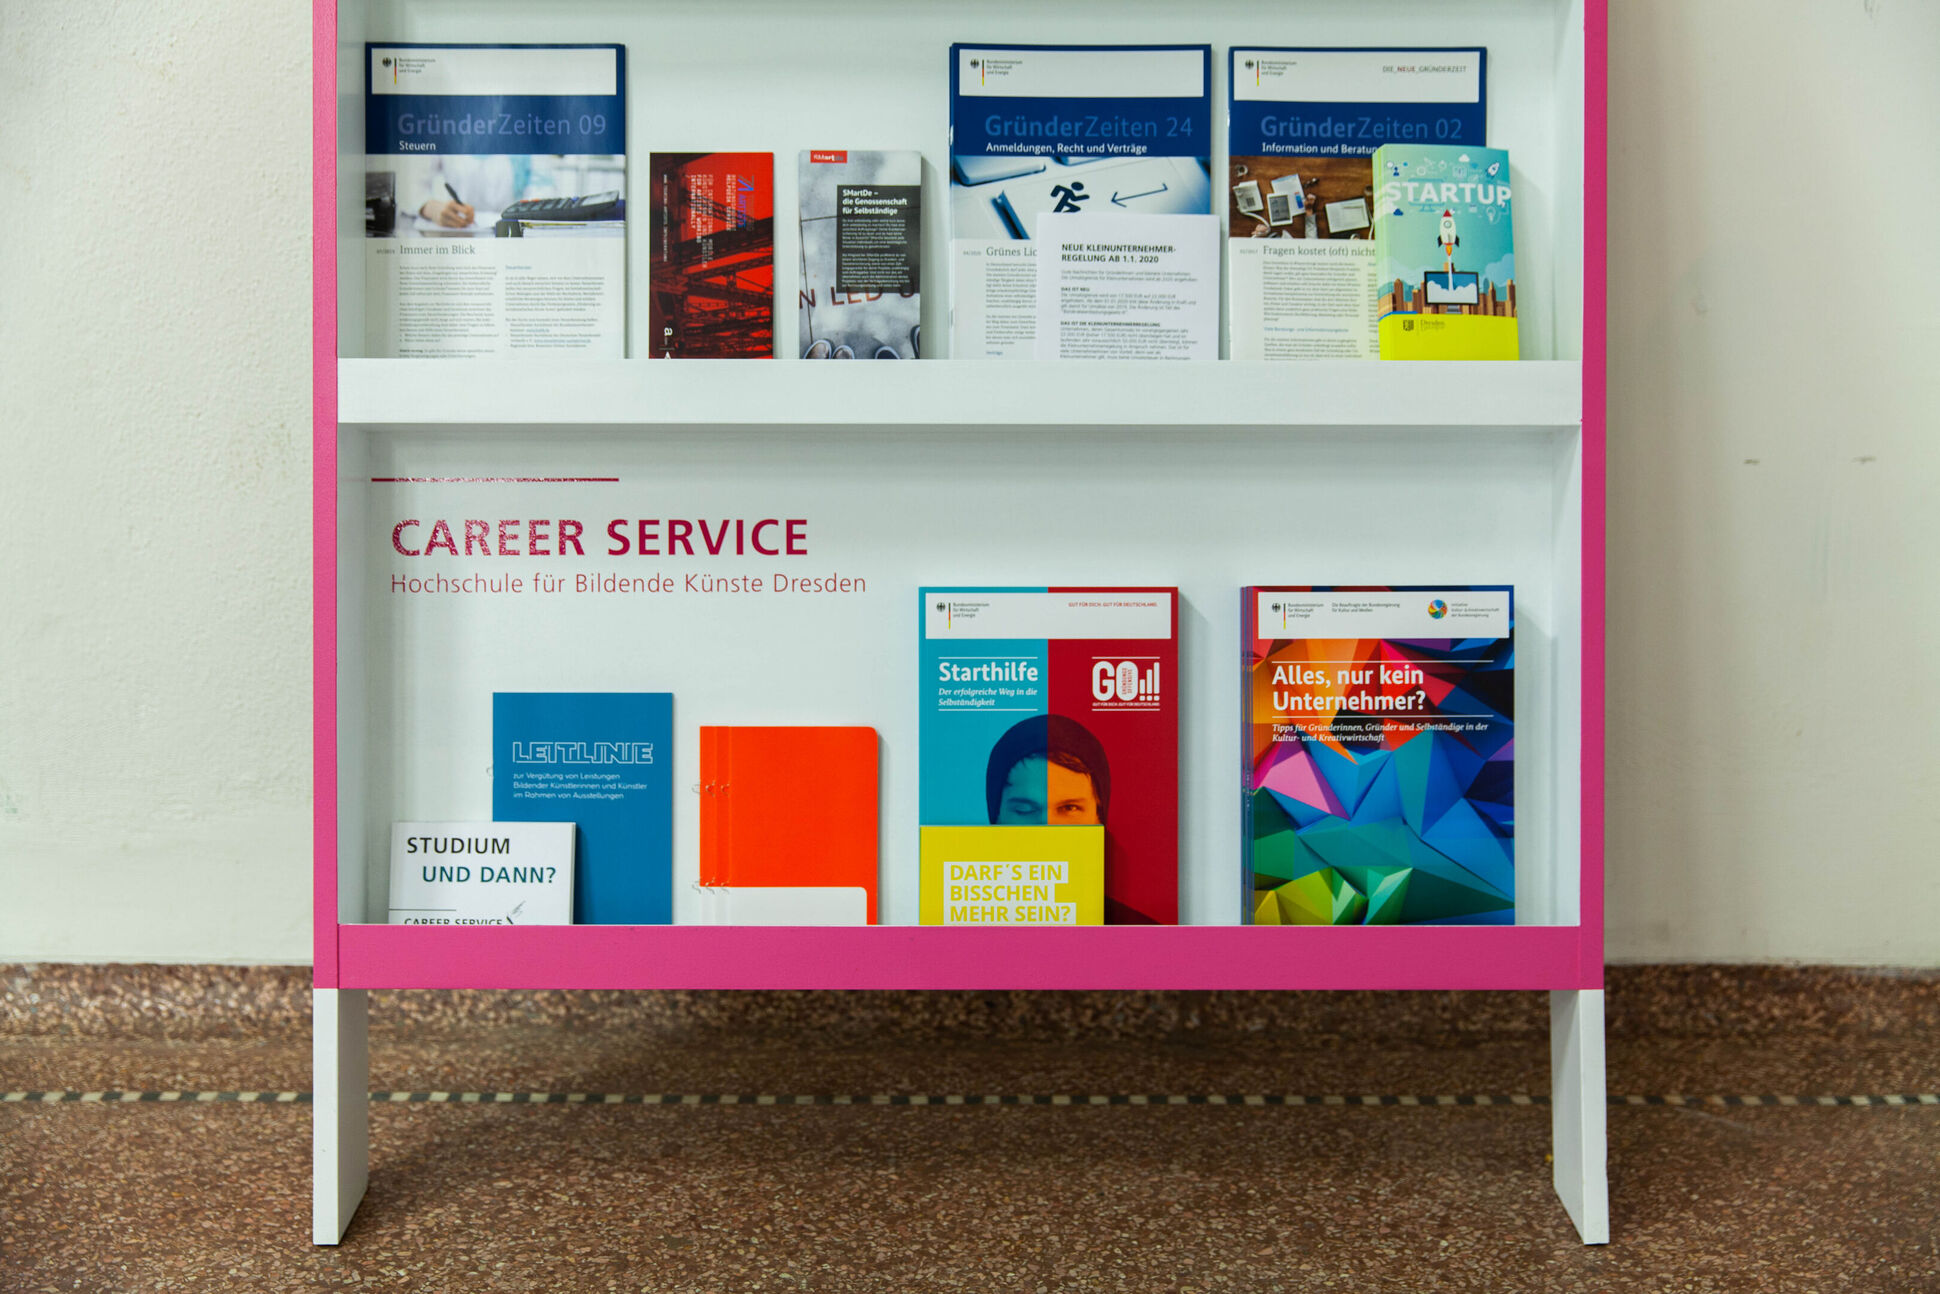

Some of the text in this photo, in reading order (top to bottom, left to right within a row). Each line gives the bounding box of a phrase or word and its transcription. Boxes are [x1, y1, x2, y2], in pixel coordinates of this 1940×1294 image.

[399, 113, 607, 135] GründerZeiten 09
[985, 115, 1193, 137] GründerZeiten 24
[1261, 115, 1462, 139] GründerZeiten 02
[399, 141, 436, 151] Steuern
[986, 142, 1147, 155] Anmeldungen, Recht und Verträge
[1262, 143, 1377, 155] Information und Beratun
[1386, 181, 1512, 206] STARTUP
[854, 207, 898, 216] Selbständige
[400, 245, 433, 255] Immer
[436, 245, 449, 255] im
[452, 245, 476, 255] Blick
[986, 246, 1021, 257] Grünes
[1024, 247, 1038, 257] Lic
[1087, 244, 1176, 253] KLEINUNTERNEHMER-
[1263, 245, 1297, 257] Fragen
[1298, 246, 1326, 256] kostet
[1329, 245, 1348, 256] (oft)
[1351, 246, 1376, 256] nicht
[1062, 254, 1106, 262] REGELUNG
[392, 519, 808, 556] CAREER SERVICE
[392, 573, 866, 593] Hochschule für Bildende Künste Dresden
[938, 661, 1038, 682] Starthilfe
[1272, 664, 1424, 688] Alles, nur kein
[939, 687, 1037, 698] Der erfolgreiche Weg in die
[938, 698, 995, 708] Selbständigkeit
[1273, 689, 1426, 711] Unternehmer?
[1272, 724, 1293, 733] Tipps
[1294, 724, 1306, 733] für
[1308, 724, 1364, 732] Gründerinnen,
[1416, 723, 1464, 732] Selbständige
[1272, 734, 1385, 743] Kultur- und Kreativwirtschaft
[512, 741, 654, 764] LEITLINIE
[580, 773, 620, 781] Leistungen
[573, 792, 624, 800] Ausstellungen
[407, 837, 510, 855] STUDIUM
[422, 866, 557, 883] UND DANN?
[1029, 865, 1062, 881] EIN
[950, 885, 1048, 902] BISSCHEN
[950, 905, 1071, 922] MEHR SEIN?
